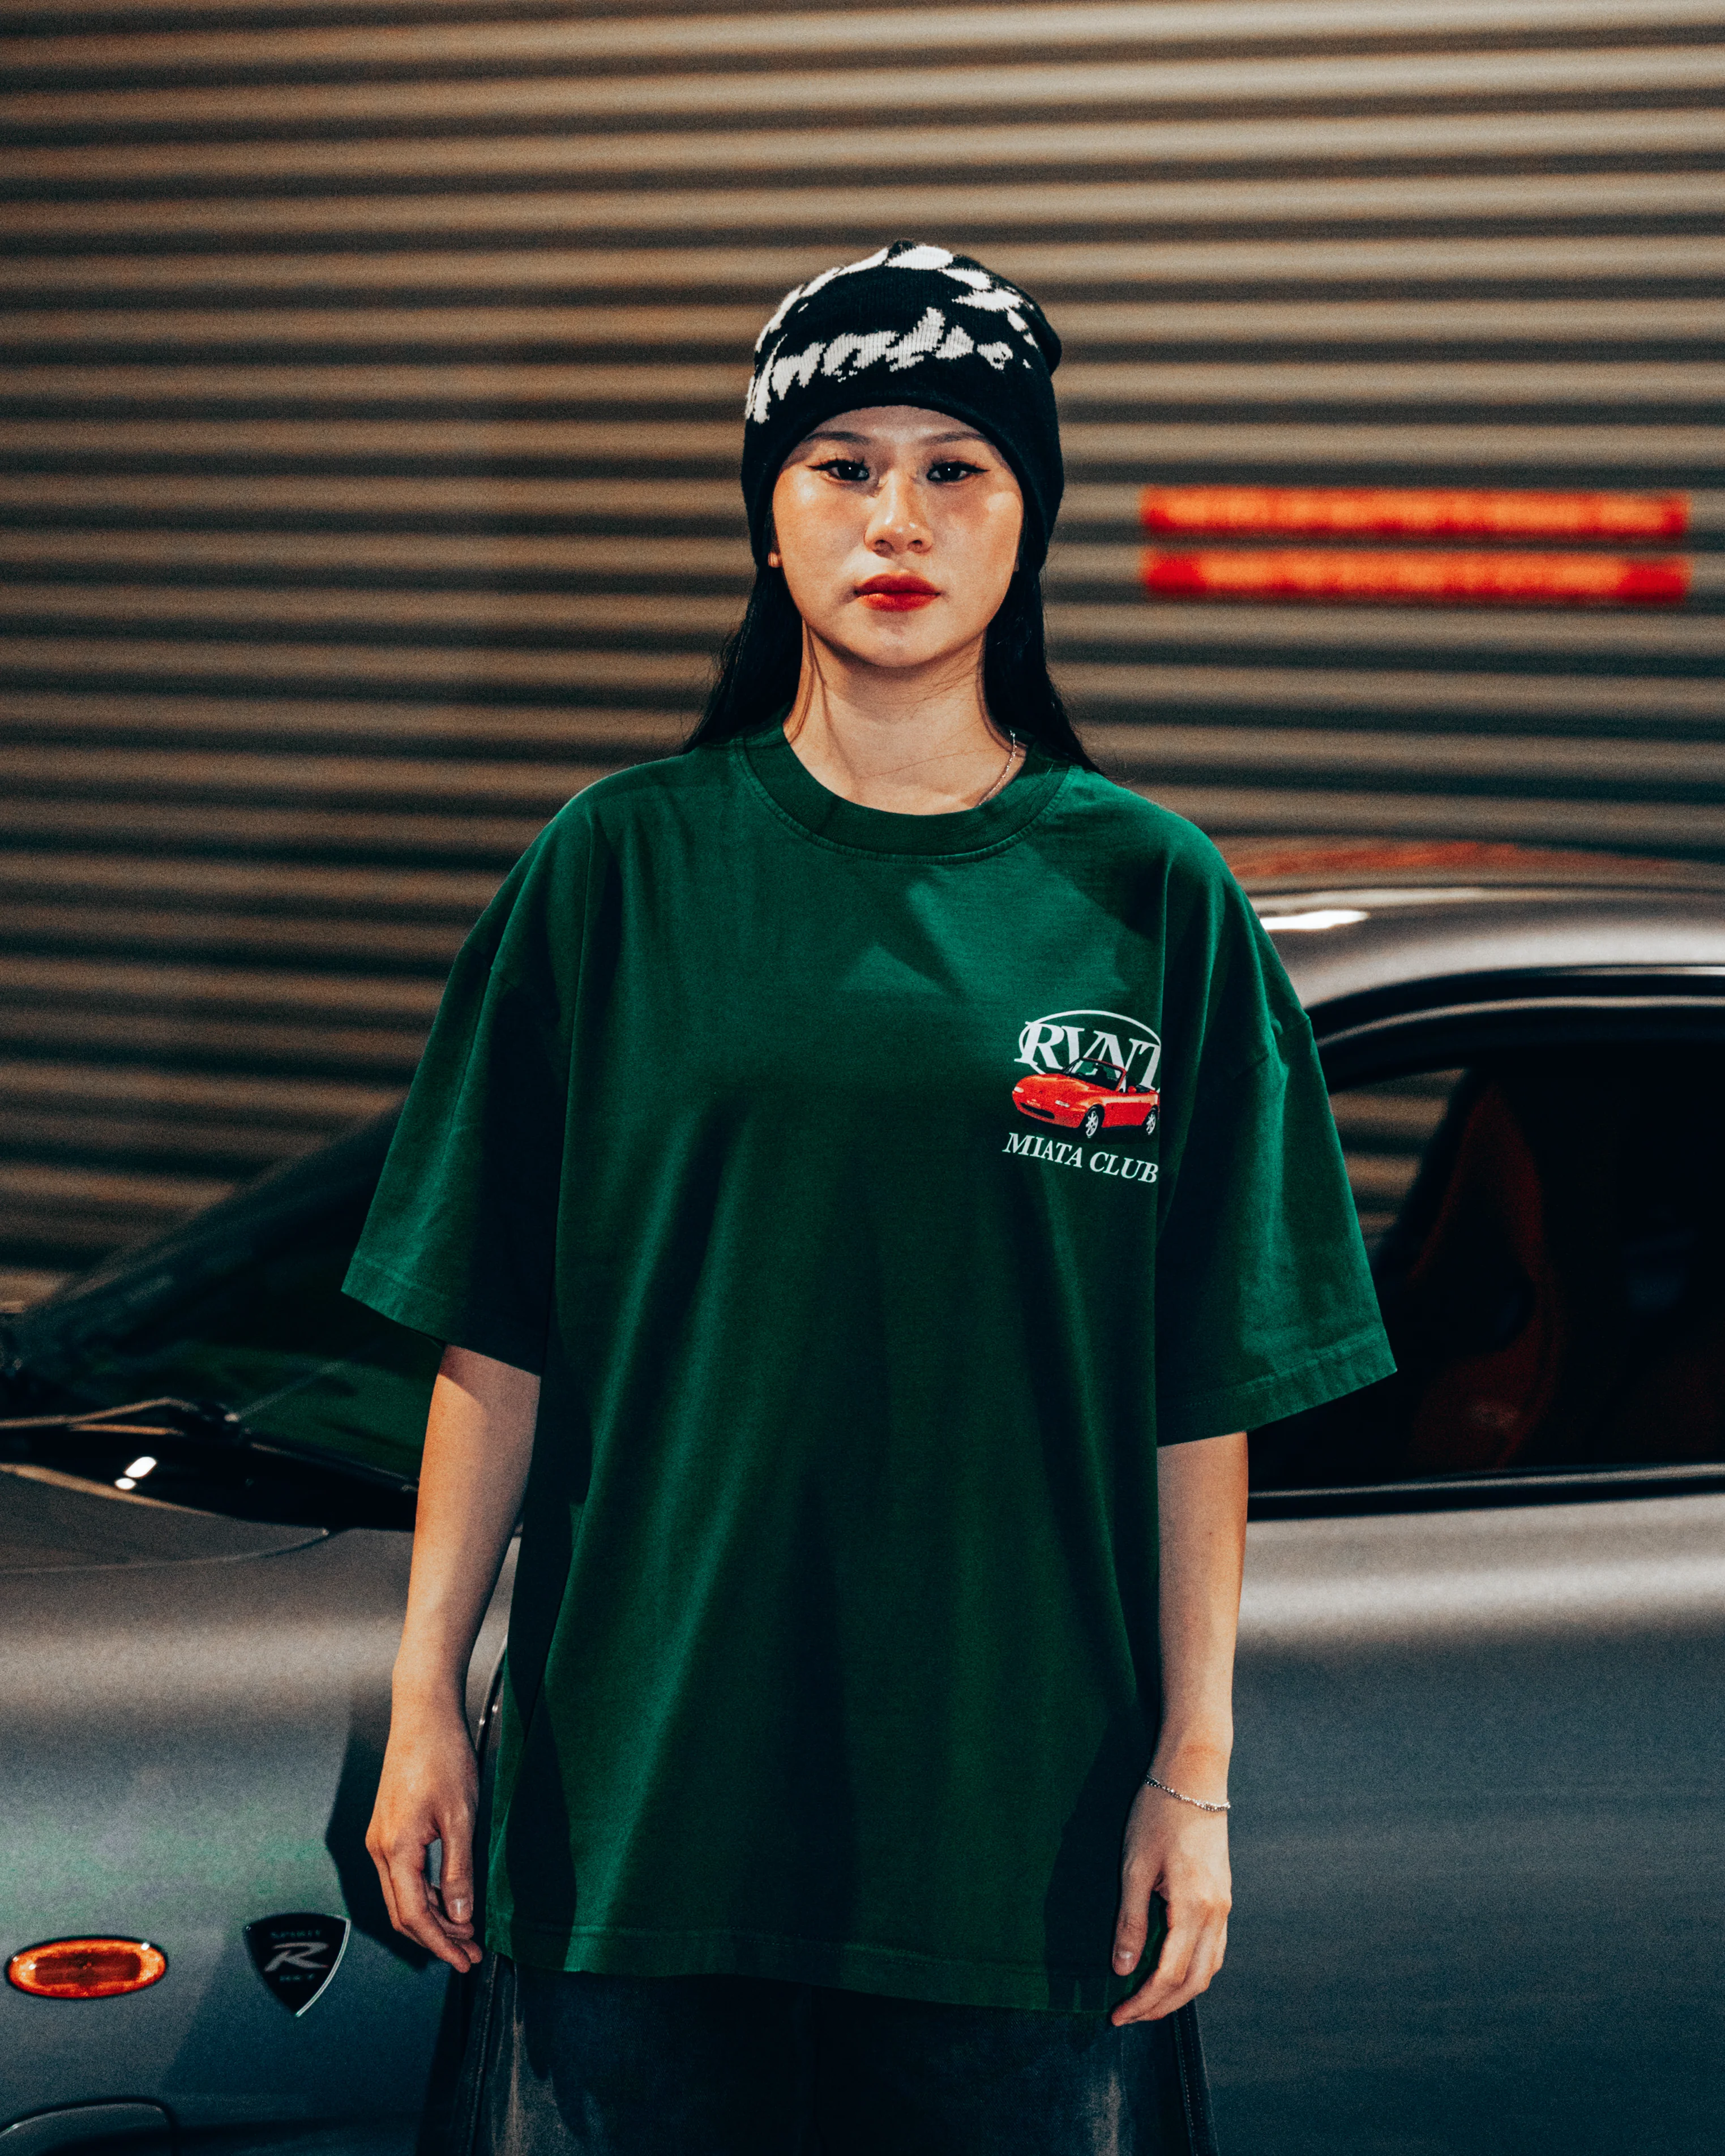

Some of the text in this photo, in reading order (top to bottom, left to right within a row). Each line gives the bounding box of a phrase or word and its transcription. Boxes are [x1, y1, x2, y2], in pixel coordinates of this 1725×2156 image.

[1003, 1133, 1158, 1183] MIATA CLUB
[264, 1942, 329, 1972] R
